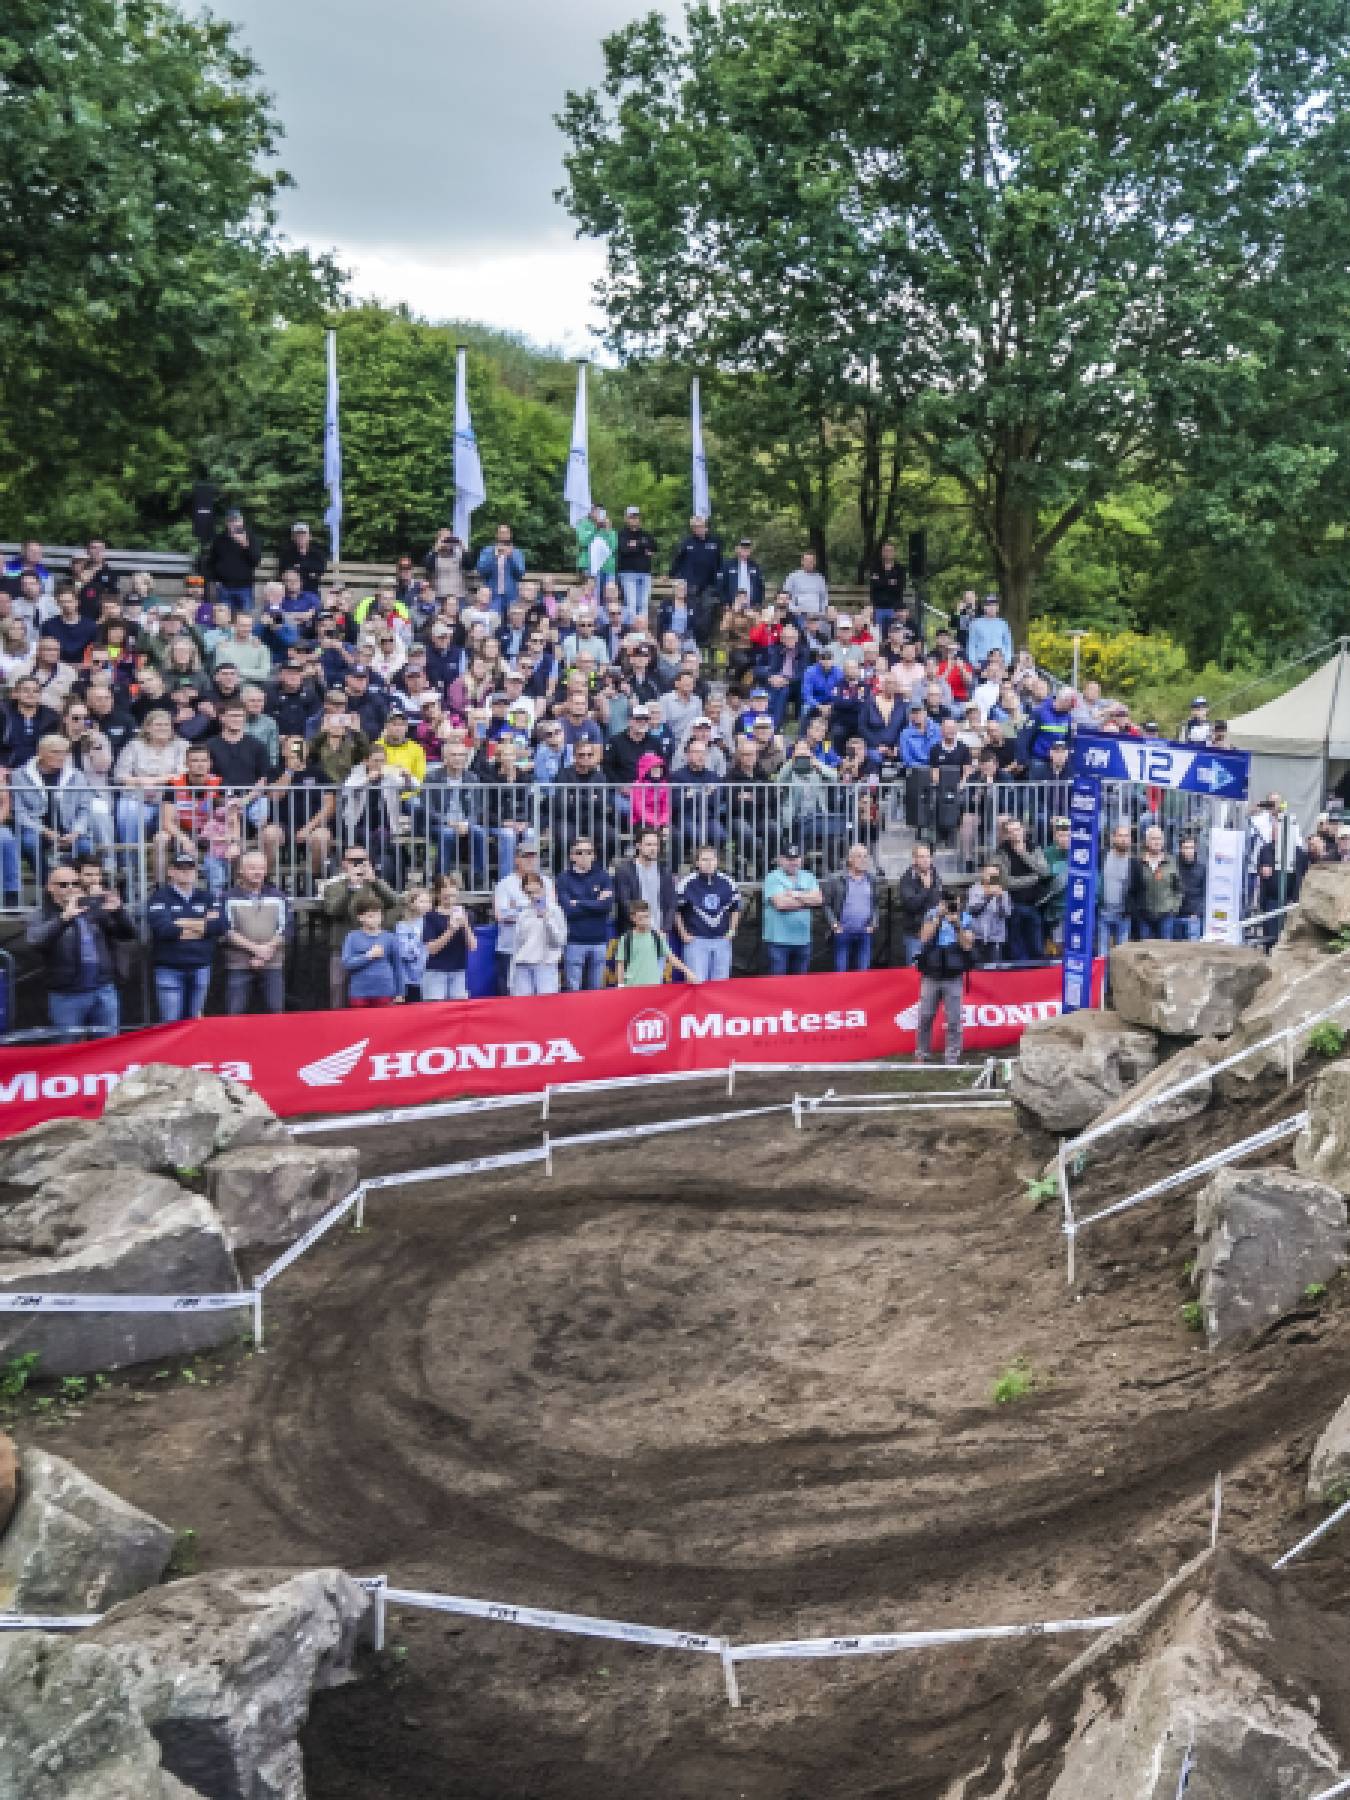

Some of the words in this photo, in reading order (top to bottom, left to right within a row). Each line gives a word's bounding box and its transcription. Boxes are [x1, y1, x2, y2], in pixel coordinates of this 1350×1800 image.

[1137, 750, 1175, 784] 12
[679, 1008, 868, 1040] Montesa
[368, 1037, 585, 1082] HONDA
[0, 1061, 253, 1102] Mona
